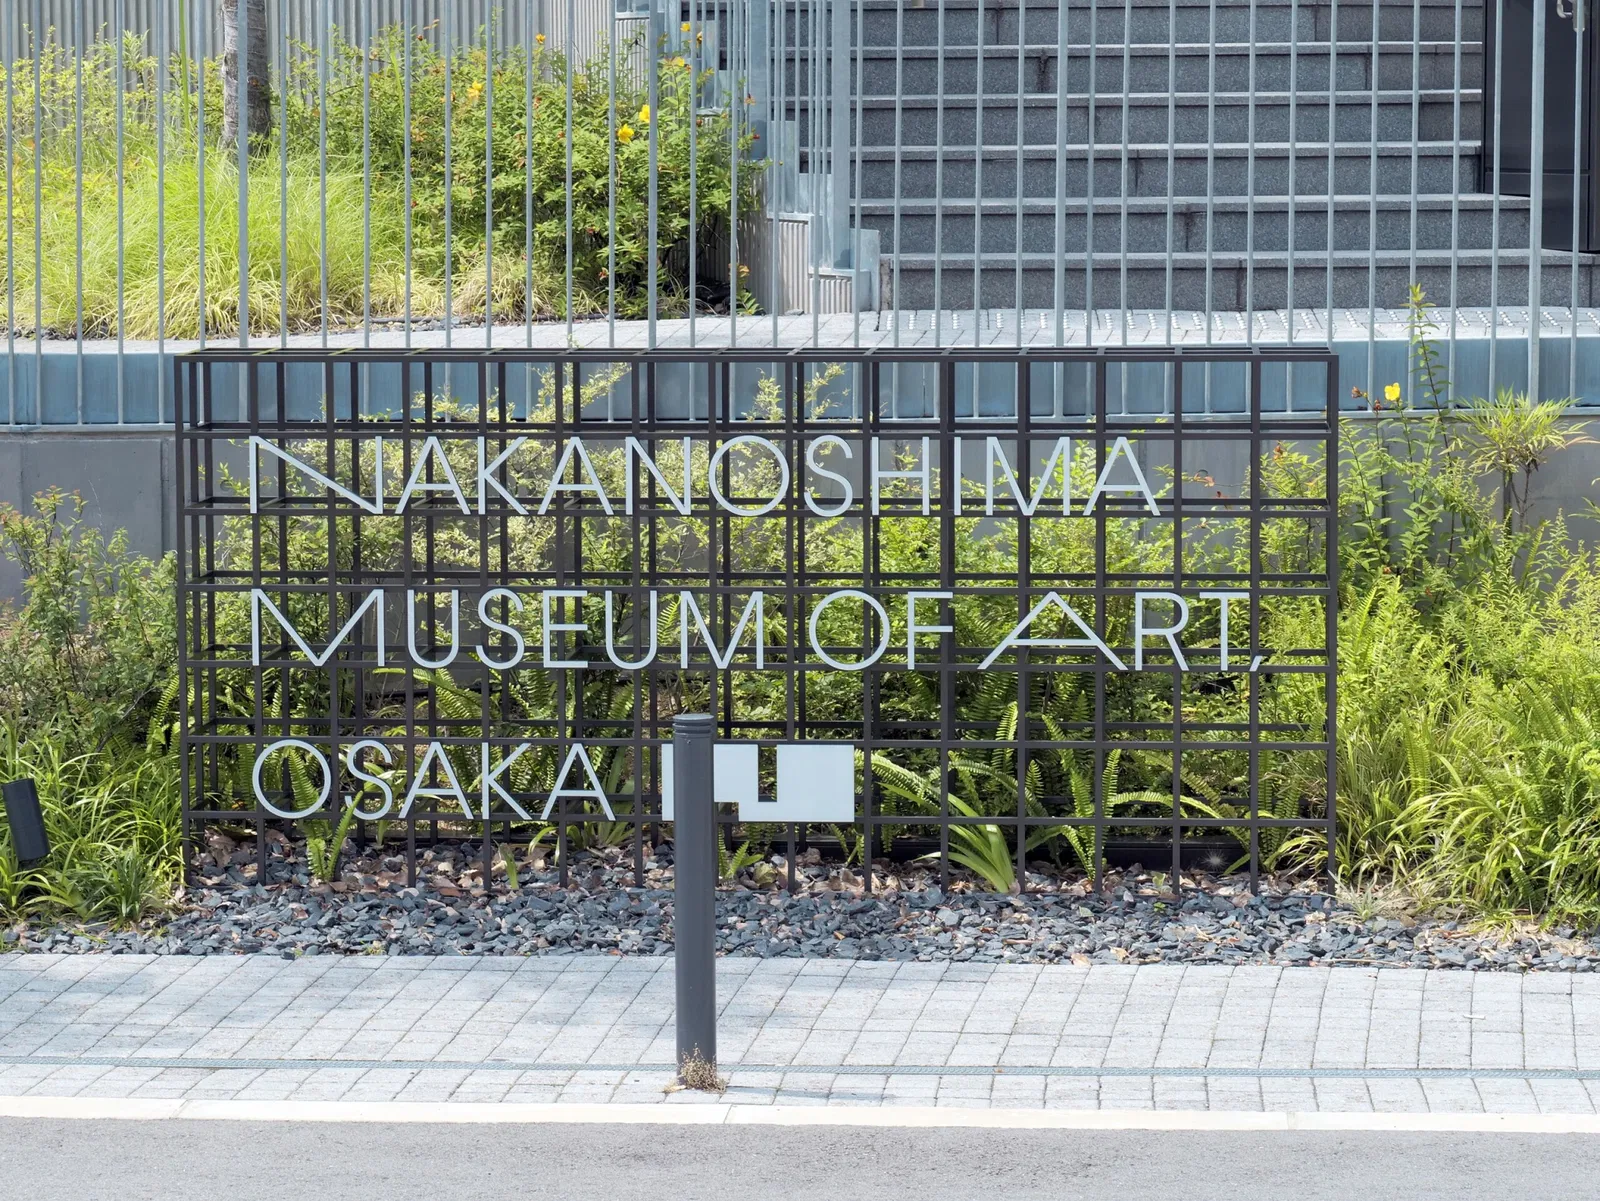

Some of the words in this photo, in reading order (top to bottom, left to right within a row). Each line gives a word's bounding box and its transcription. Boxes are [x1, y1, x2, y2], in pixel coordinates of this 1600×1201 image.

[249, 434, 1161, 517] NAKANOSHIMA
[251, 588, 764, 670] MUSEUM
[808, 590, 953, 671] OF
[976, 591, 1263, 672] ART,
[252, 739, 616, 821] OSAKA
